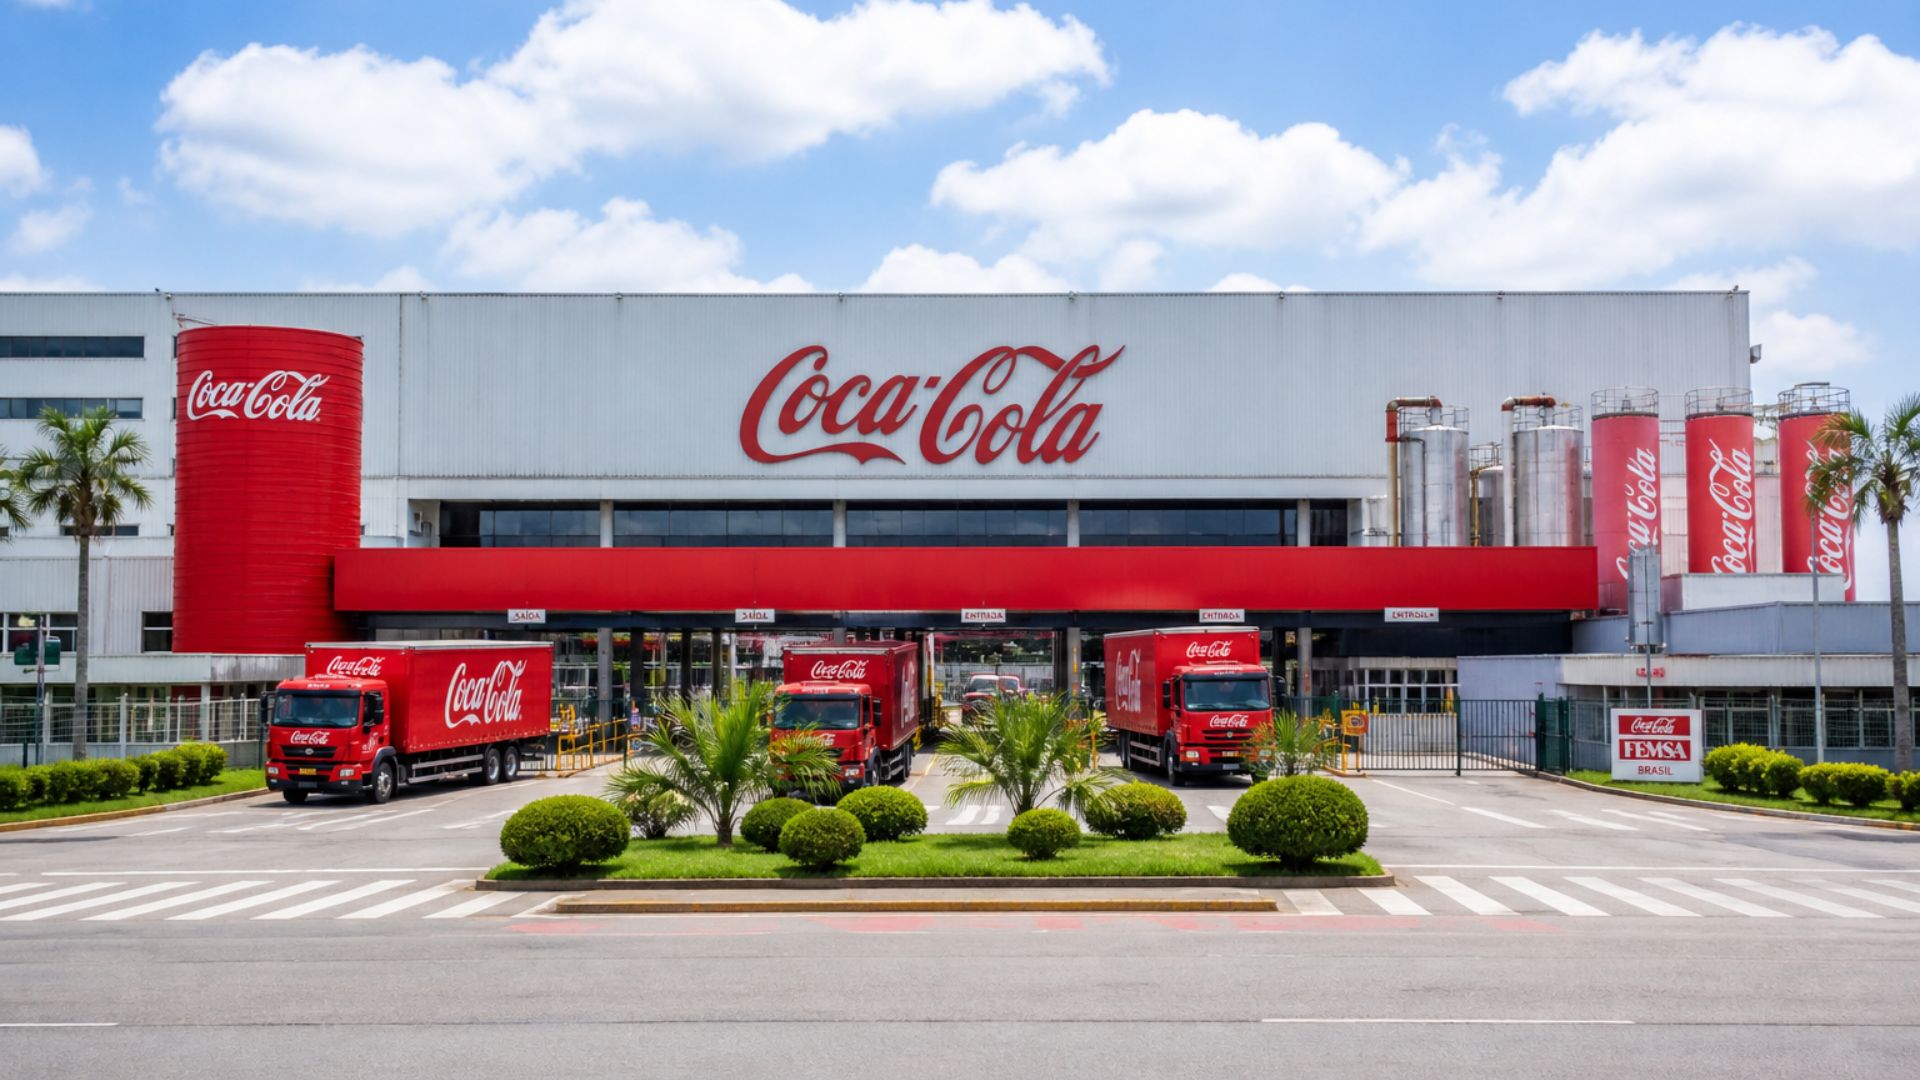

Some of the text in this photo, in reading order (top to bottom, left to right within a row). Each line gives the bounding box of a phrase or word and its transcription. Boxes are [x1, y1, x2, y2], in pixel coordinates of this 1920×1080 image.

[187, 370, 330, 421] Coca-Cola
[739, 345, 1126, 465] Coca-Cola
[445, 659, 527, 729] Coca-Cola
[1624, 741, 1687, 759] FEMSA
[1637, 765, 1674, 776] BRASIL
